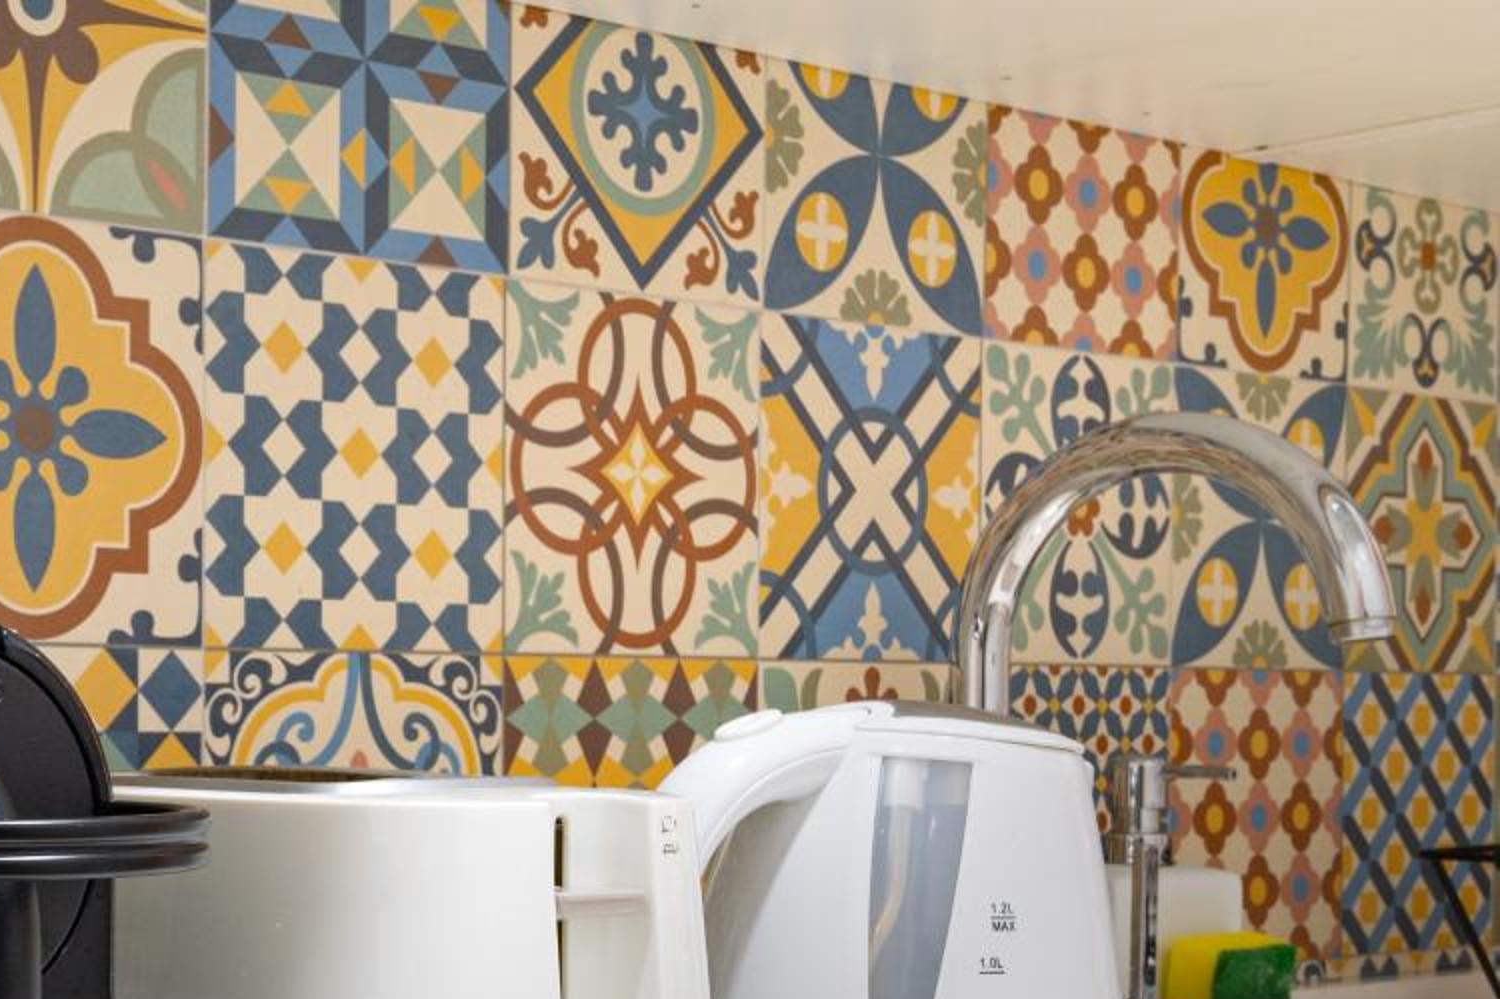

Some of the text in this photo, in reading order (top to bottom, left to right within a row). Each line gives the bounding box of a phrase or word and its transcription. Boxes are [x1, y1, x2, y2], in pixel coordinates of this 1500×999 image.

[991, 902, 1015, 914] 1.2L
[991, 919, 1017, 932] MAX
[979, 956, 1004, 969] 1.0L
